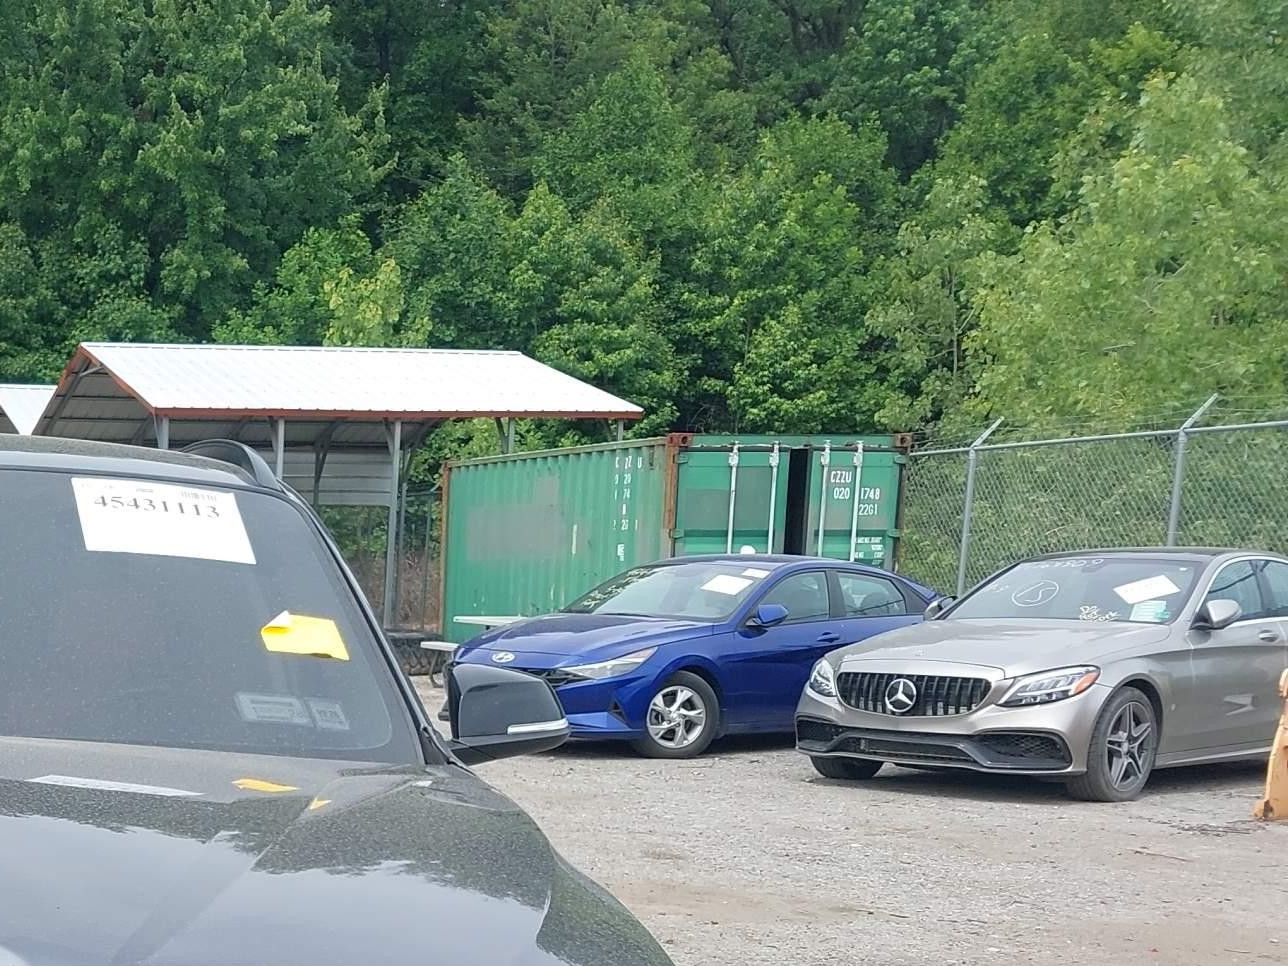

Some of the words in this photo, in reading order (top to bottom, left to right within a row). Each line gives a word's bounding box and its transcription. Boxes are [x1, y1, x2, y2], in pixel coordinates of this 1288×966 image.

[830, 470, 853, 484] CZZU
[833, 487, 851, 500] 020
[860, 487, 881, 500] 1748
[94, 495, 221, 519] 45431113
[858, 503, 878, 516] 22G1
